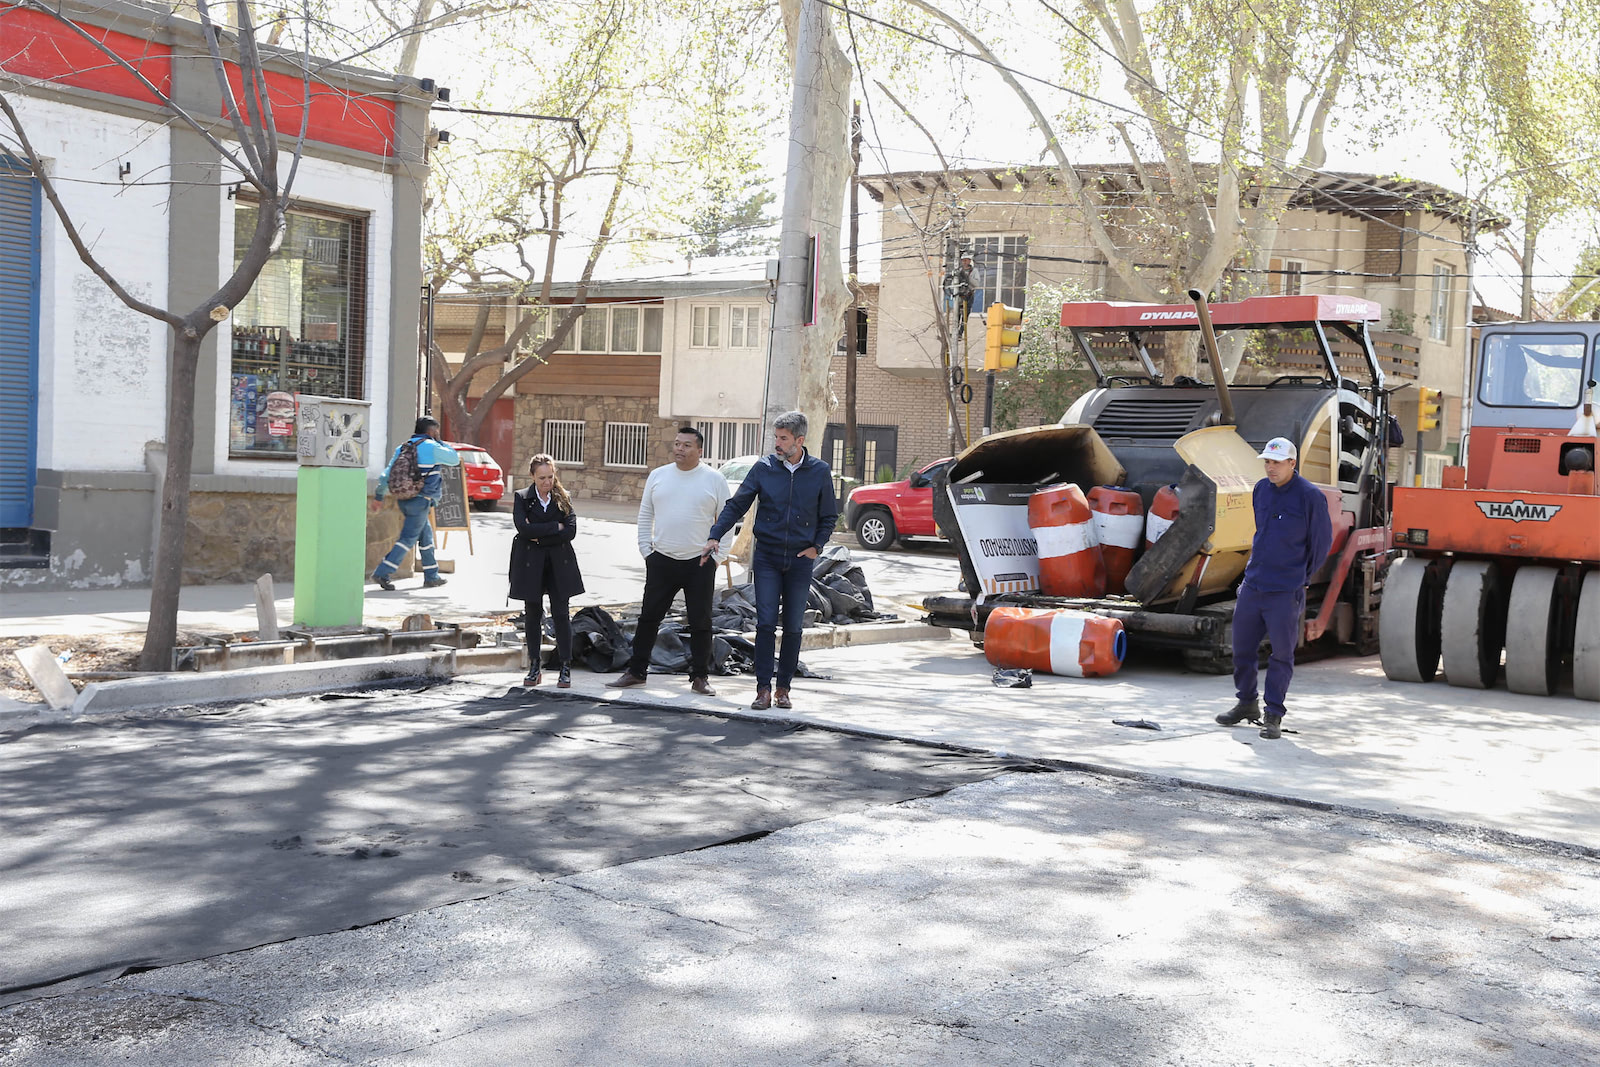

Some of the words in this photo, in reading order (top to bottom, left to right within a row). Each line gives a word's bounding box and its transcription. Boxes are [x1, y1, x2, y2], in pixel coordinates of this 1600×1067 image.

[1140, 310, 1214, 320] DYNAPA
[1336, 303, 1368, 314] DYNAPAC
[1490, 504, 1546, 519] HAMM
[980, 538, 1016, 558] CERRADO
